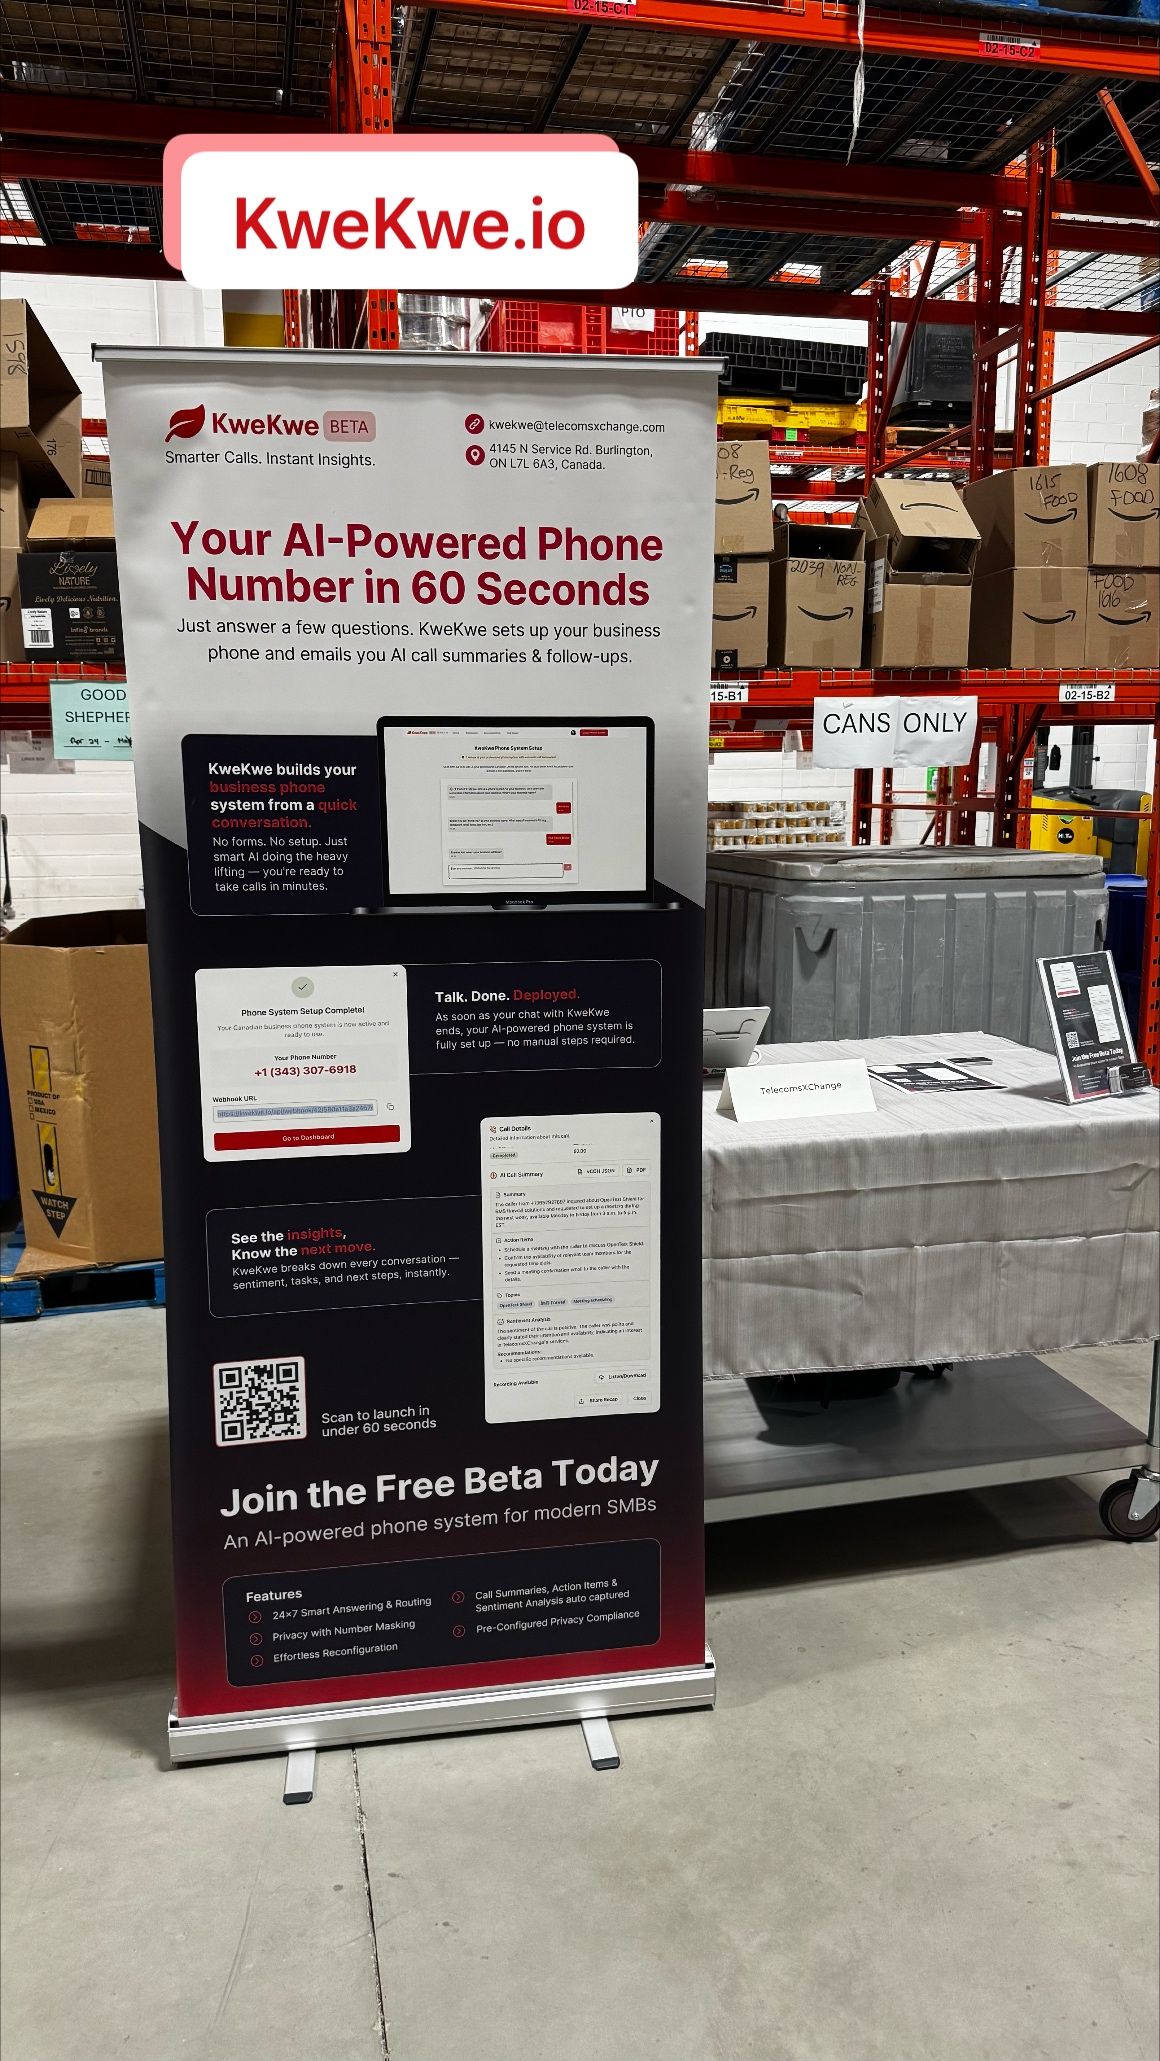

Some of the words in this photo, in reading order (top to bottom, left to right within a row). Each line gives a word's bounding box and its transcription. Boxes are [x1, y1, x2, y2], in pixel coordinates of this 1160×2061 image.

[985, 42, 1035, 58] 02-15-C2
[213, 413, 319, 436] KweKwe
[331, 420, 368, 433] BETA
[490, 420, 665, 434] kwekwe@telecomsxchange.com
[490, 444, 516, 453] 4145
[520, 444, 528, 453] N
[532, 444, 571, 454] Service
[576, 445, 592, 454] Rd.
[596, 445, 652, 457] Burlington,
[166, 451, 220, 463] Smarter
[225, 451, 262, 464] Calls.
[267, 452, 314, 465] Instant
[319, 453, 375, 468] Insights.
[490, 458, 506, 468] ON
[511, 458, 529, 468] L7L
[534, 459, 557, 470] 6A3,
[562, 459, 605, 470] Canada.
[1109, 463, 1149, 484] 1608
[1030, 473, 1062, 491] 1615
[1044, 493, 1078, 510] FOOD
[1111, 490, 1154, 506] FOOD
[171, 521, 271, 555] Your
[284, 523, 526, 560] AI-Powered
[539, 527, 663, 561] Phone
[58, 577, 91, 586] NATURE
[188, 567, 354, 603] Number
[365, 568, 400, 603] in
[412, 570, 465, 604] 60
[478, 572, 649, 606] Seconds
[1094, 574, 1134, 591] FOOD
[177, 618, 211, 632] Just
[217, 622, 276, 633] answer
[282, 623, 290, 634] a
[296, 620, 326, 634] few
[332, 621, 413, 638] questions.
[420, 622, 486, 636] KweKwe
[493, 624, 524, 636] sets
[530, 626, 548, 640] up
[554, 627, 588, 640] your
[594, 623, 660, 637] business
[209, 645, 259, 662] phone
[266, 647, 294, 660] and
[301, 647, 351, 661] emails
[357, 651, 385, 664] you
[391, 648, 405, 662] AI
[412, 648, 437, 662] call
[443, 649, 526, 662] summaries
[532, 649, 542, 662] &
[547, 649, 632, 666] follow-ups.
[81, 689, 126, 700] GOOD
[1063, 691, 1112, 702] 02-15-B2
[824, 713, 890, 734] CANS
[904, 712, 967, 733] ONLY
[209, 763, 273, 775] KweKwe
[277, 763, 320, 775] builds
[324, 766, 356, 778] your
[210, 780, 276, 793] business
[280, 781, 326, 795] phone
[210, 800, 265, 813] system
[268, 799, 303, 811] from
[306, 802, 315, 811] a
[318, 799, 357, 813] quick
[212, 816, 312, 828] conversation.
[435, 991, 468, 1003] Talk.
[471, 990, 510, 1002] Done.
[513, 989, 580, 1004] Deployed.
[325, 1007, 364, 1015] Complete!
[255, 1068, 267, 1076] +1
[271, 1067, 300, 1078] (343)
[304, 1065, 356, 1074] 307-6918
[26, 1090, 51, 1099] PRODUCT
[760, 1083, 842, 1094] TelecomsXChange
[34, 1106, 56, 1115] MEXICO
[41, 1196, 69, 1210] WATCH
[46, 1209, 66, 1220] STEP
[232, 1233, 258, 1244] See
[261, 1230, 284, 1242] the
[287, 1228, 347, 1242] insights,
[232, 1248, 272, 1261] Know
[275, 1246, 298, 1258] the
[301, 1244, 332, 1256] next
[335, 1242, 376, 1253] move.
[322, 1413, 353, 1424] Scan
[357, 1411, 370, 1421] to
[374, 1407, 415, 1419] launch
[419, 1405, 429, 1415] in
[322, 1425, 359, 1437] under
[363, 1422, 380, 1433] 60
[384, 1418, 436, 1432] seconds
[220, 1484, 297, 1517] Join
[307, 1480, 366, 1508] the
[377, 1474, 454, 1502] Free
[465, 1466, 542, 1494] Beta
[552, 1457, 659, 1487] Today
[224, 1535, 248, 1550] An
[255, 1522, 364, 1547] AI-powered
[372, 1520, 428, 1539] phone
[434, 1513, 498, 1532] system
[504, 1508, 529, 1523] for
[535, 1504, 600, 1520] modern
[608, 1498, 656, 1514] SMBs
[247, 1591, 302, 1602] Features
[476, 1591, 492, 1600] Call
[496, 1586, 549, 1598] Summaries,
[552, 1583, 581, 1592] Action
[584, 1581, 609, 1589] Items
[274, 1652, 320, 1662] Effortless
[323, 1644, 398, 1657] Reconfiguration
